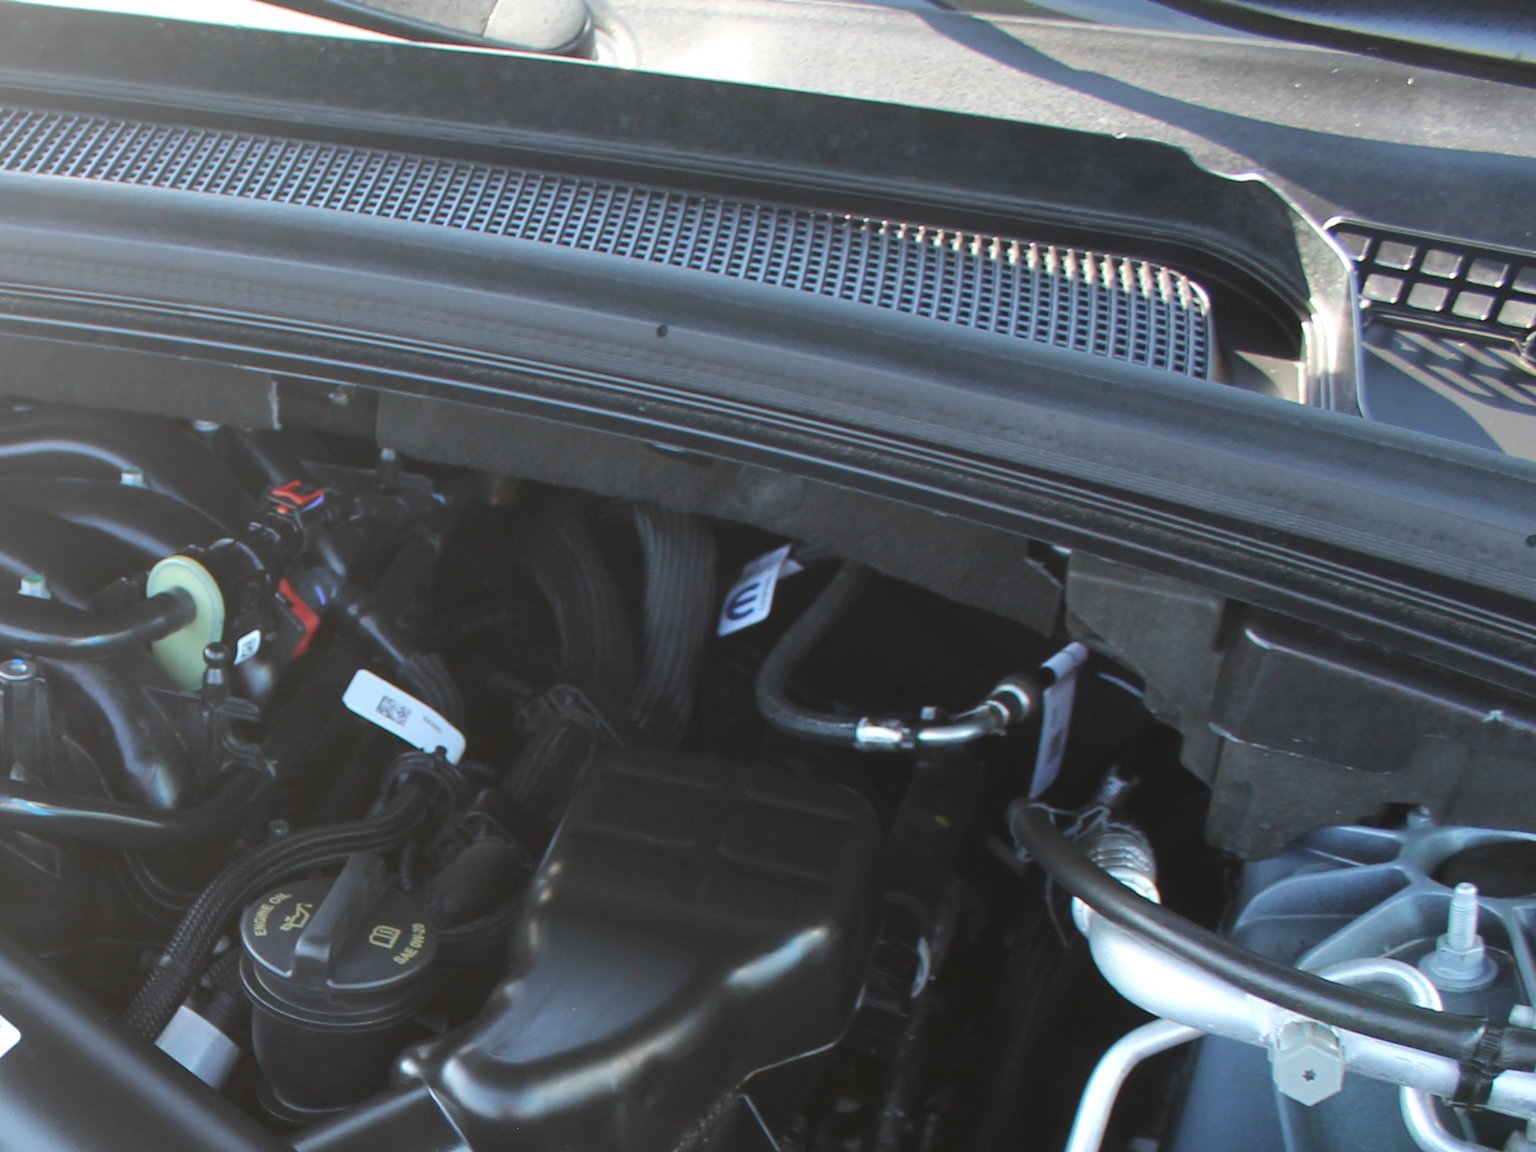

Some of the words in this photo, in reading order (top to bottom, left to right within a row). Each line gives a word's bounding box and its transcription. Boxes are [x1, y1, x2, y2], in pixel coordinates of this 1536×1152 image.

[254, 903, 274, 936] ENGINE
[269, 892, 292, 904] OIL
[393, 947, 419, 965] SAE
[409, 923, 425, 948] 0W-20
